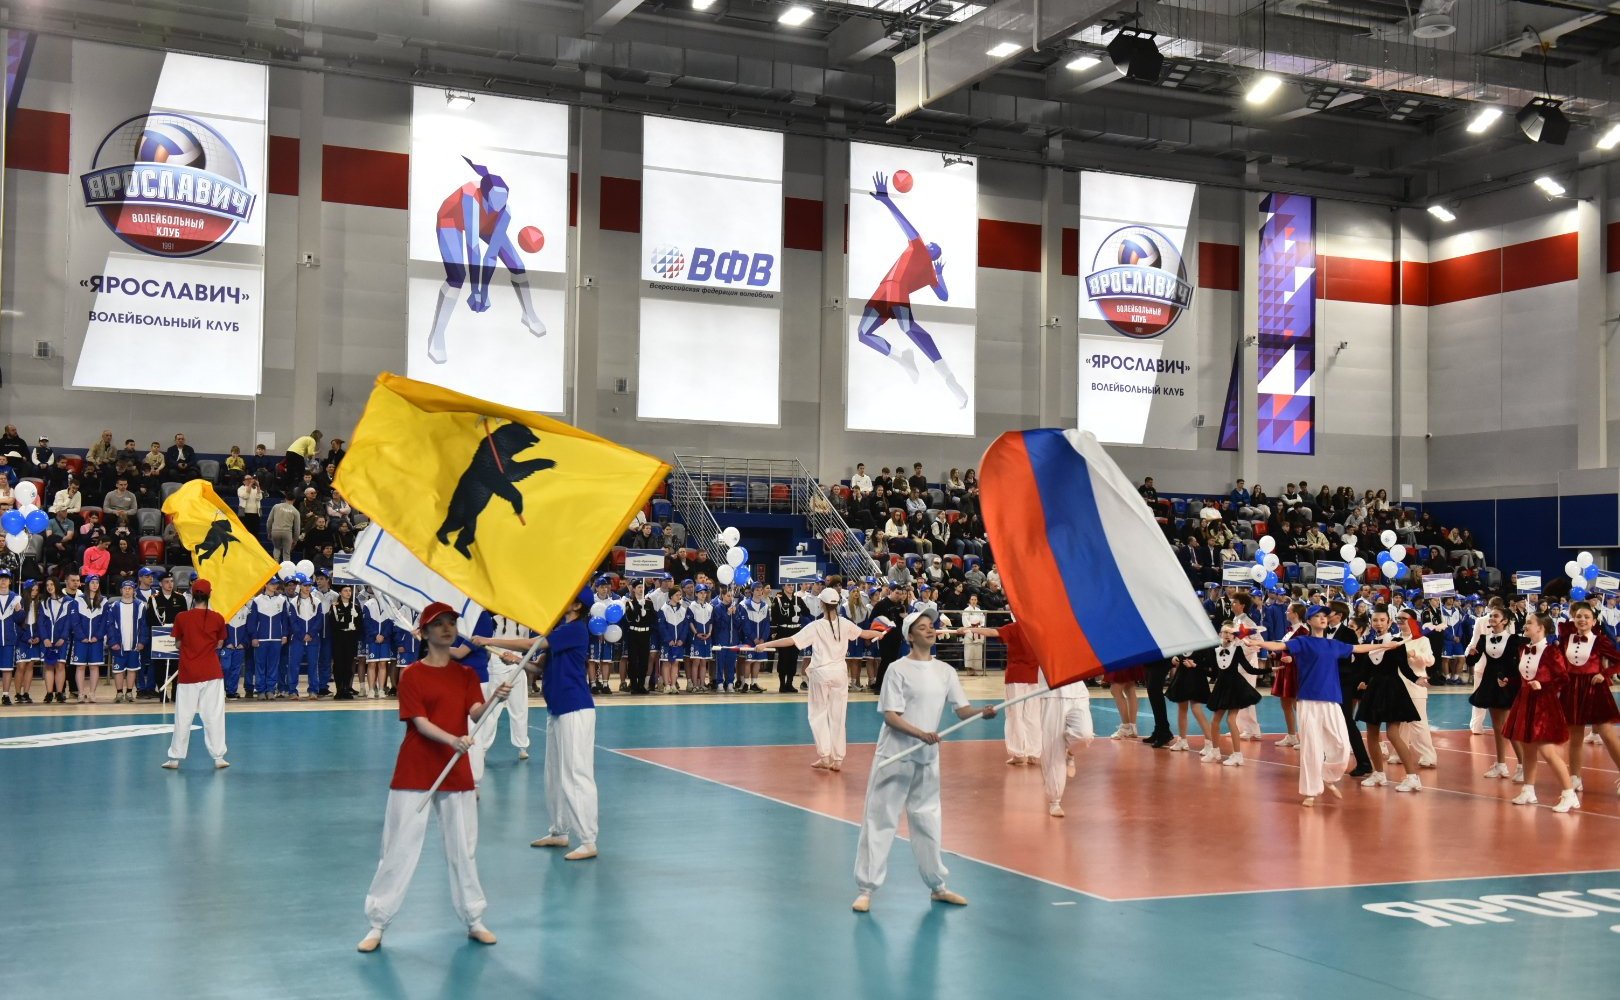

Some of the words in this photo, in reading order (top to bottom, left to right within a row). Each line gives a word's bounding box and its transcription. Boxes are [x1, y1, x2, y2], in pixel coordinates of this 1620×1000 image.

[87, 169, 248, 214] ЯРОСЛАВИЧ
[131, 212, 204, 230] ВОЛЕЙБОЛЬНЫЙ
[156, 226, 180, 238] КЛУБ
[687, 247, 774, 286] ВФВ
[79, 275, 250, 304] «ЯРОСЛАВИЧ»
[1089, 270, 1188, 303] ЯРОСЛАВИЧ
[1116, 304, 1161, 315] ВОЛЕЙБОЛЬНЫЙ
[1131, 314, 1147, 323] КЛУБ
[88, 311, 201, 329] ВОЛЕЙБОЛЬНЫЙ
[206, 319, 240, 332] КЛУБ
[1085, 354, 1191, 374] «ЯРОСЛАВИЧ»
[1091, 381, 1160, 395] ВОЛЕЙБОЛЬНЫЙ
[1163, 387, 1185, 396] КЛУБ
